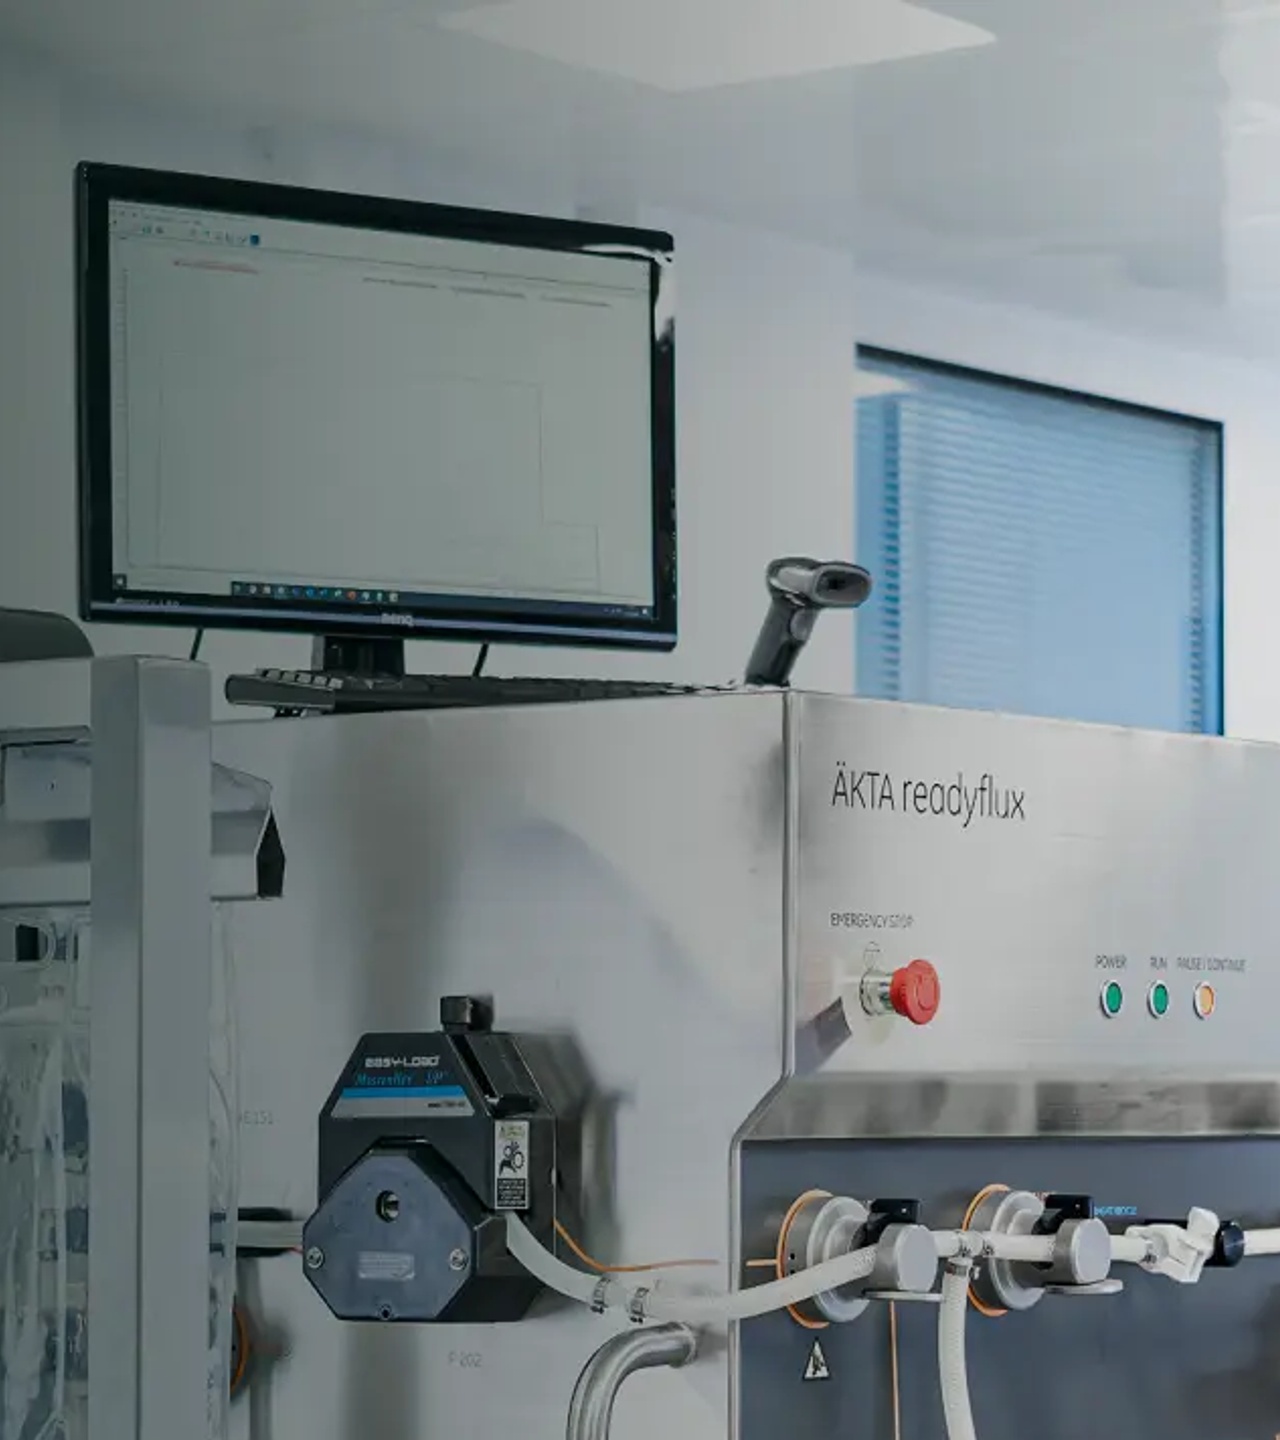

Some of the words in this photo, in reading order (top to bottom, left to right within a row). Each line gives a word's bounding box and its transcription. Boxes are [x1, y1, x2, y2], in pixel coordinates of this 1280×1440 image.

[832, 761, 895, 810] ÄKTA
[903, 771, 1025, 829] readyflux
[830, 912, 887, 928] EMERGENCY
[1095, 955, 1127, 969] POWER
[1150, 957, 1168, 970] RUN
